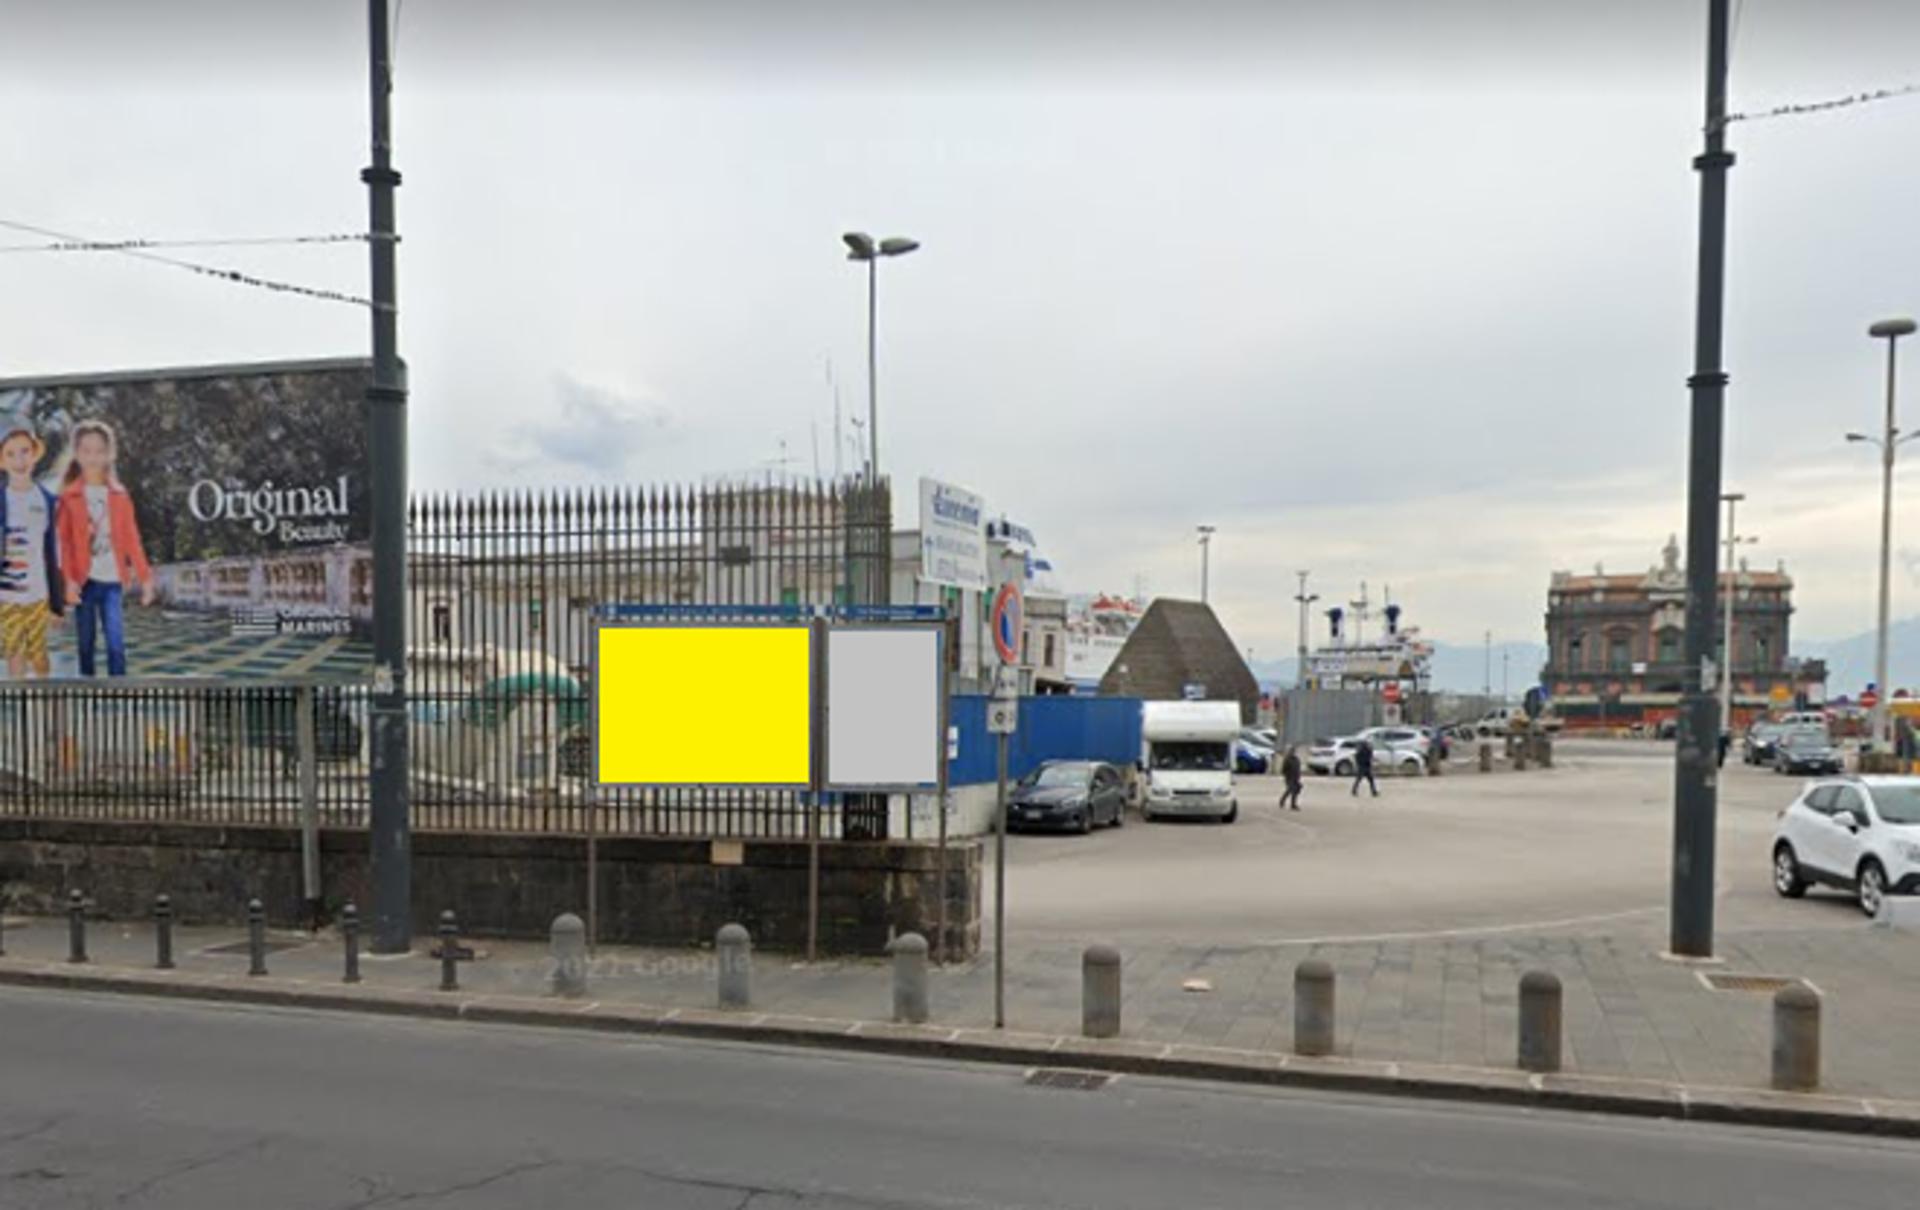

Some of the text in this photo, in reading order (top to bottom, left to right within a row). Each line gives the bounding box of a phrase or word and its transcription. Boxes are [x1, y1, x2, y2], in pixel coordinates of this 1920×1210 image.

[188, 476, 349, 534] Original
[280, 521, 349, 546] Beauty
[282, 620, 351, 634] MARINES
